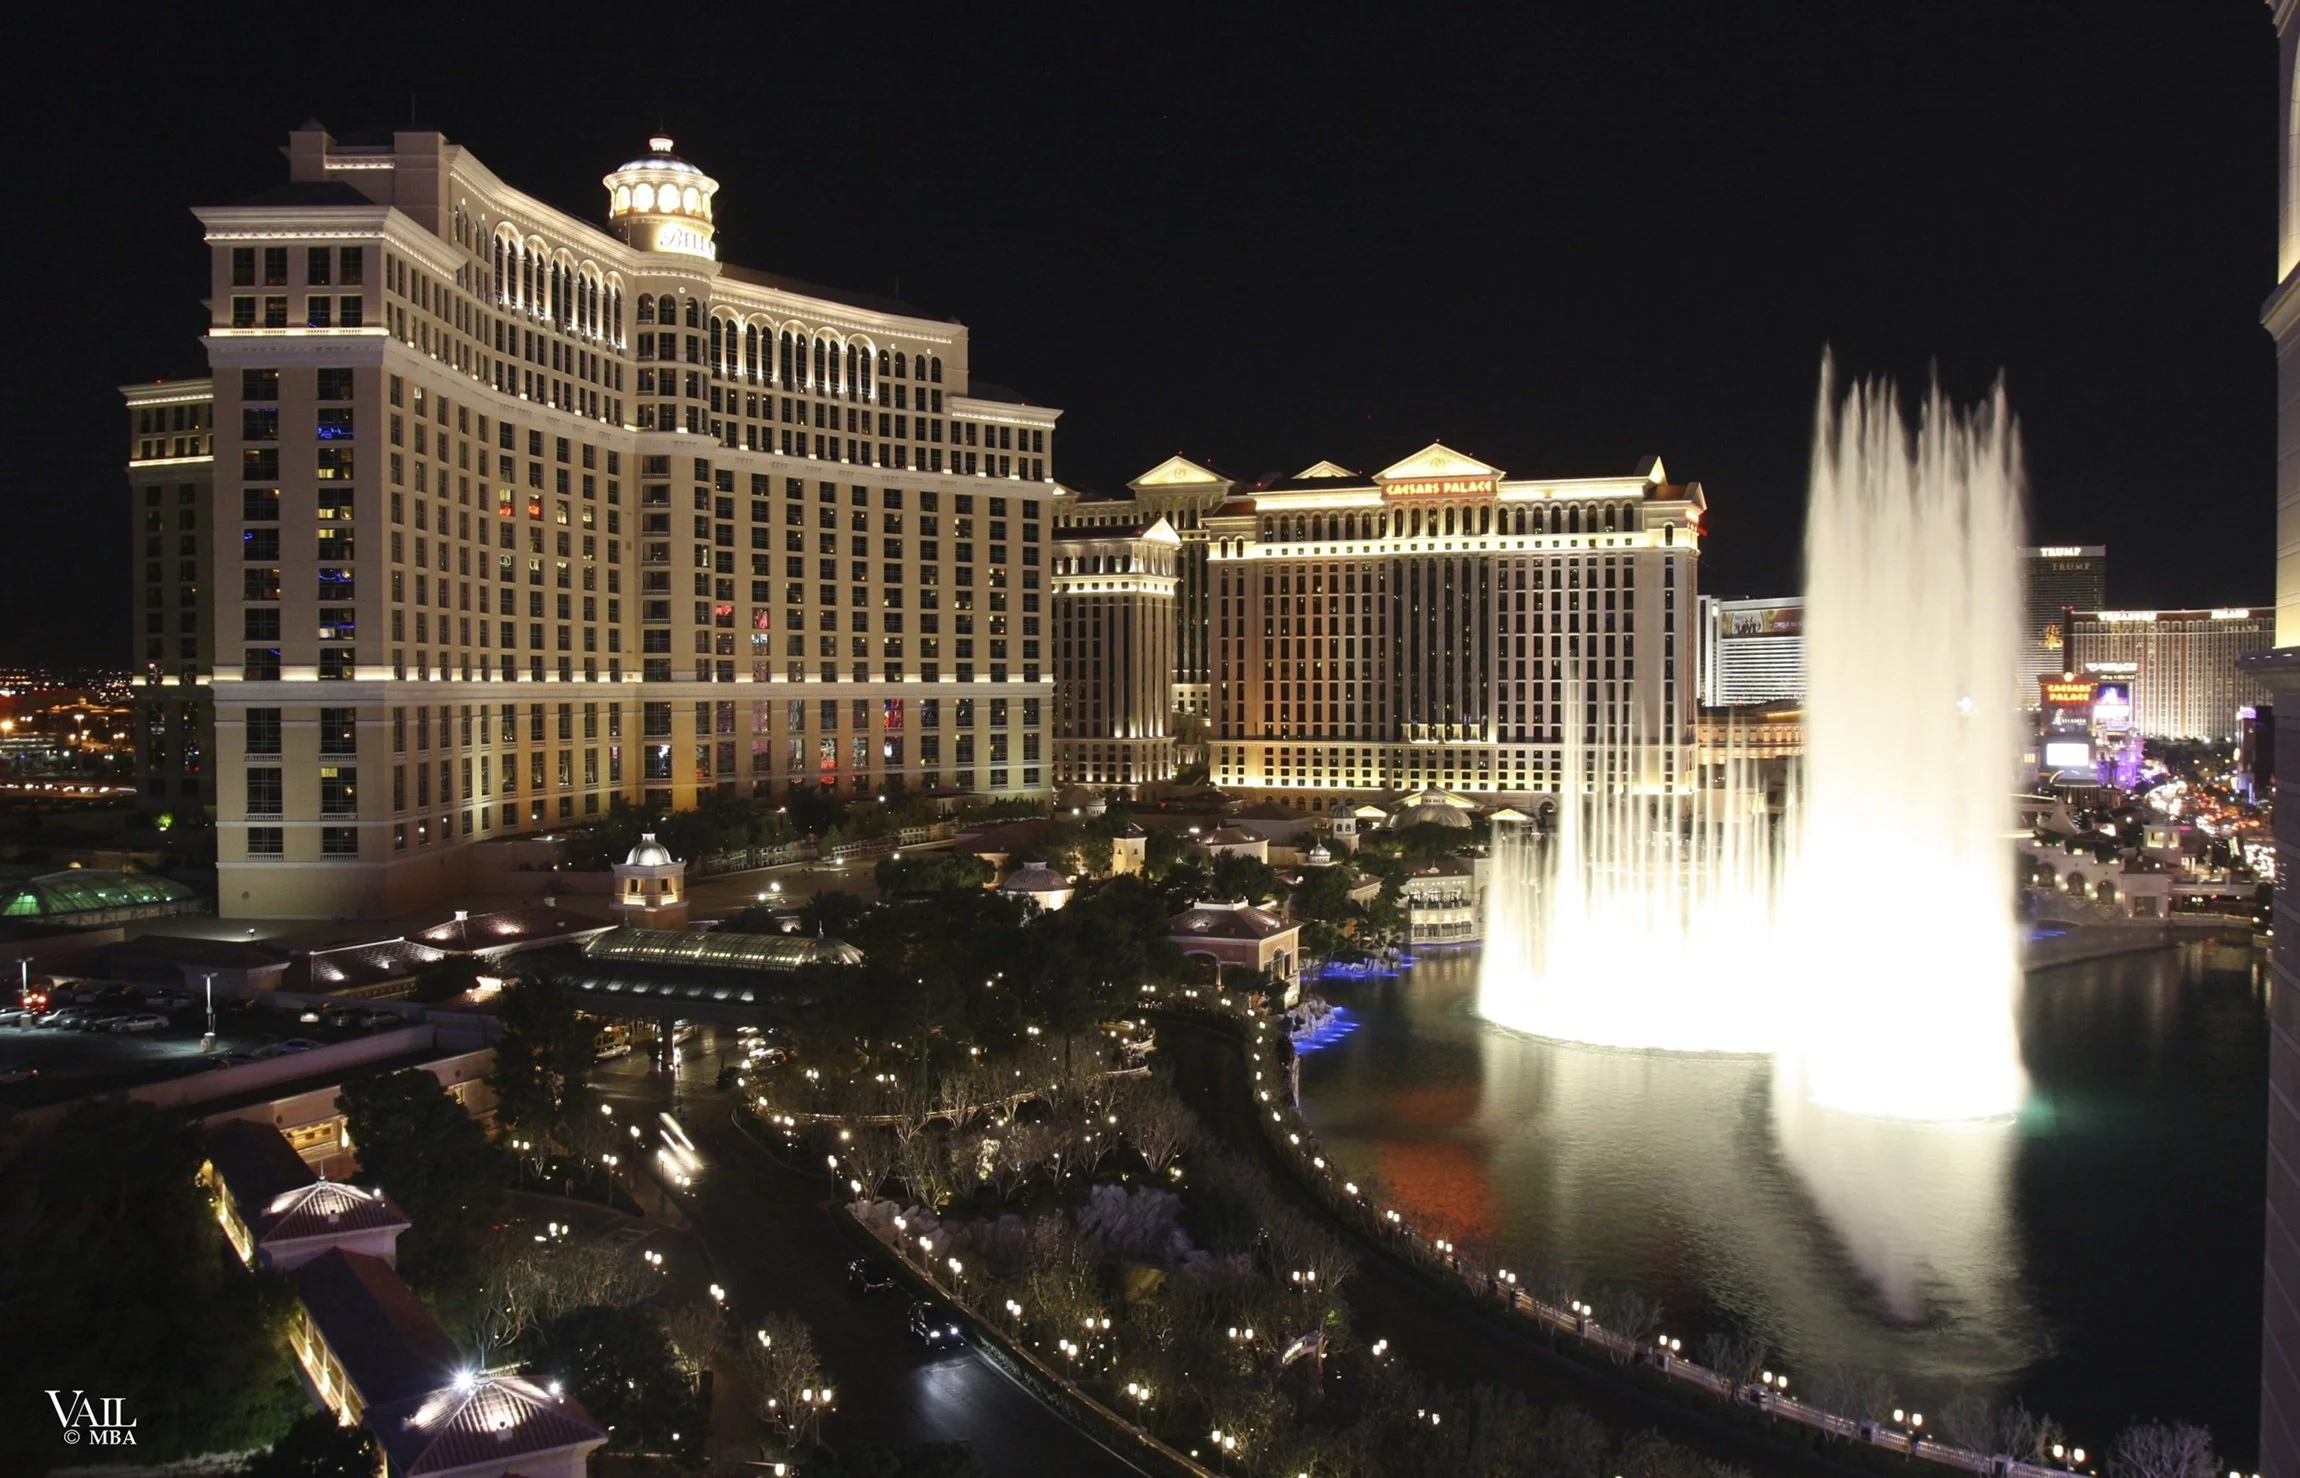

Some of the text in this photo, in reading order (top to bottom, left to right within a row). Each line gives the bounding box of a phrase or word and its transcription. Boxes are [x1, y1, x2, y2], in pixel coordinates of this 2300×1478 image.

[1386, 480, 1492, 495] CAESARS PALACE
[2040, 547, 2081, 557] TRUMP
[2047, 684, 2091, 692] CAESARS
[2049, 692, 2089, 701] PALACE
